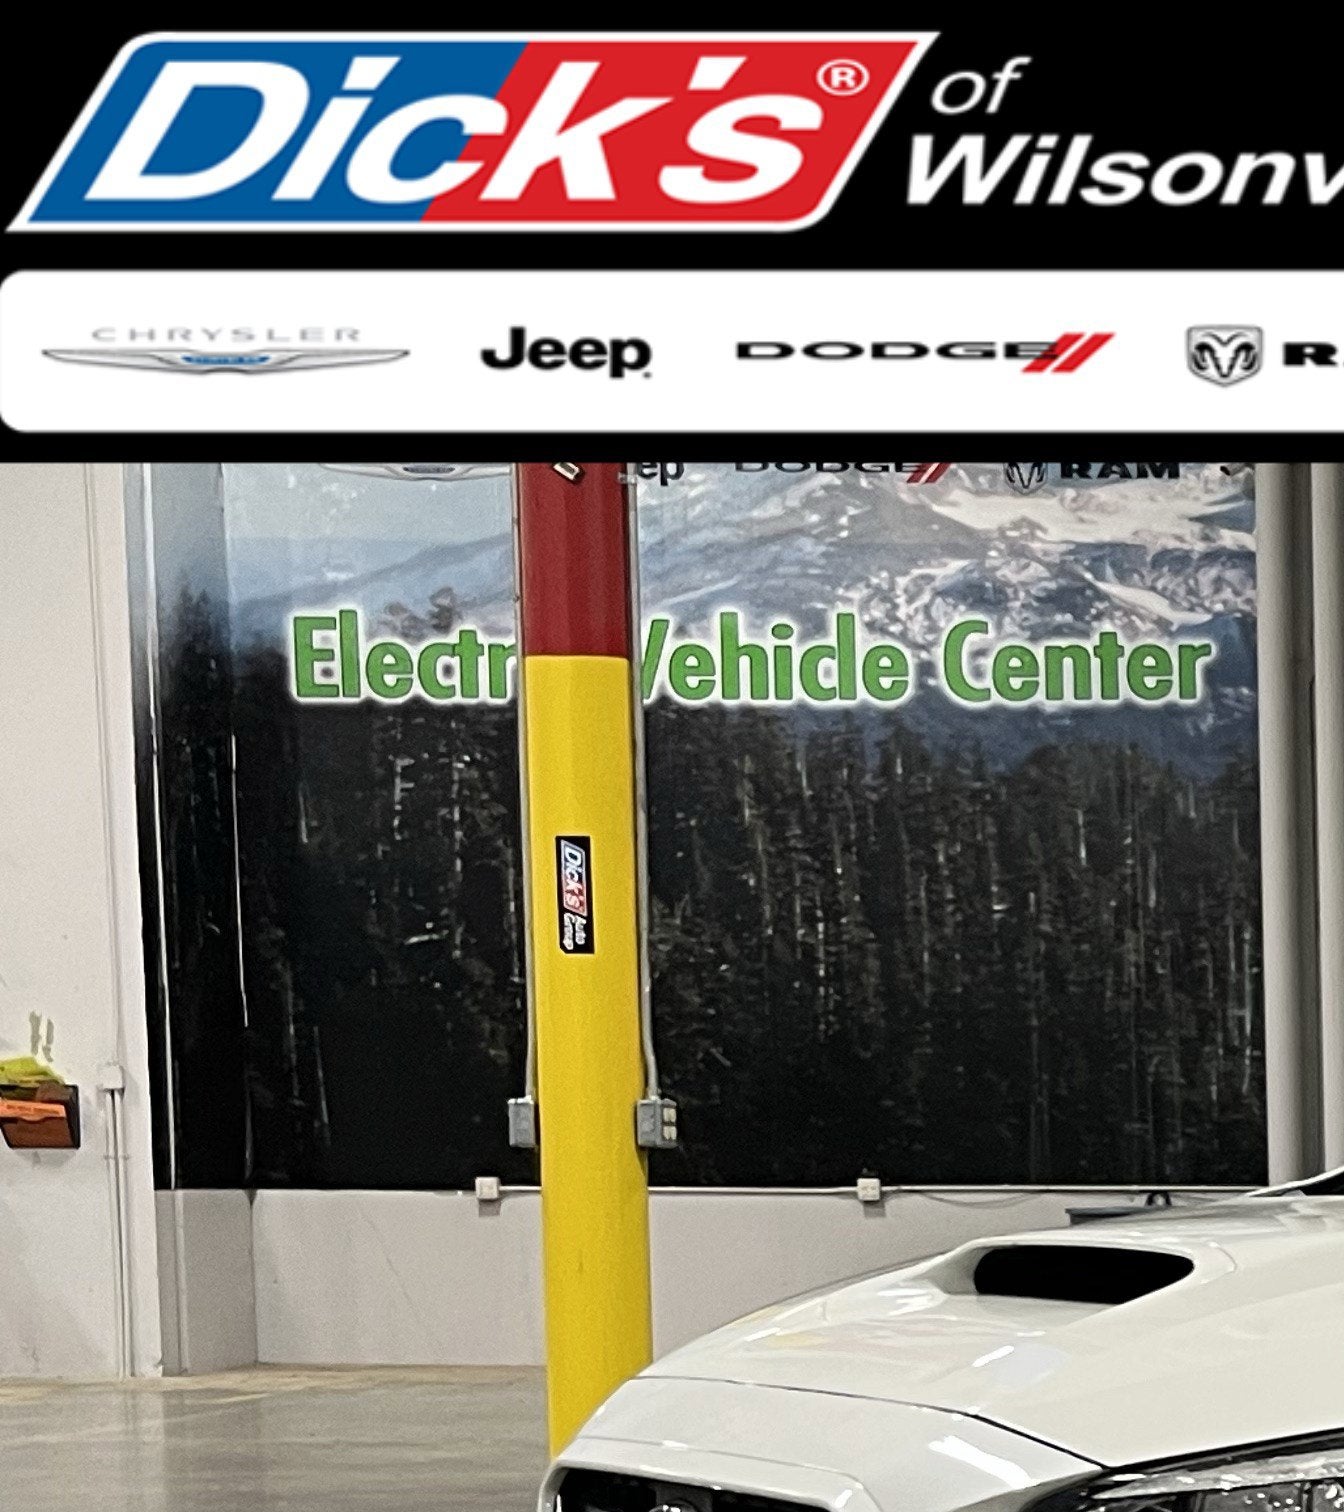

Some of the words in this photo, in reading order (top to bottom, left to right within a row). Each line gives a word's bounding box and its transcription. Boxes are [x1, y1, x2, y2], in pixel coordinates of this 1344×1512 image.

[1060, 463, 1181, 479] RAM
[293, 609, 517, 699] Electr
[943, 619, 1211, 701] Center
